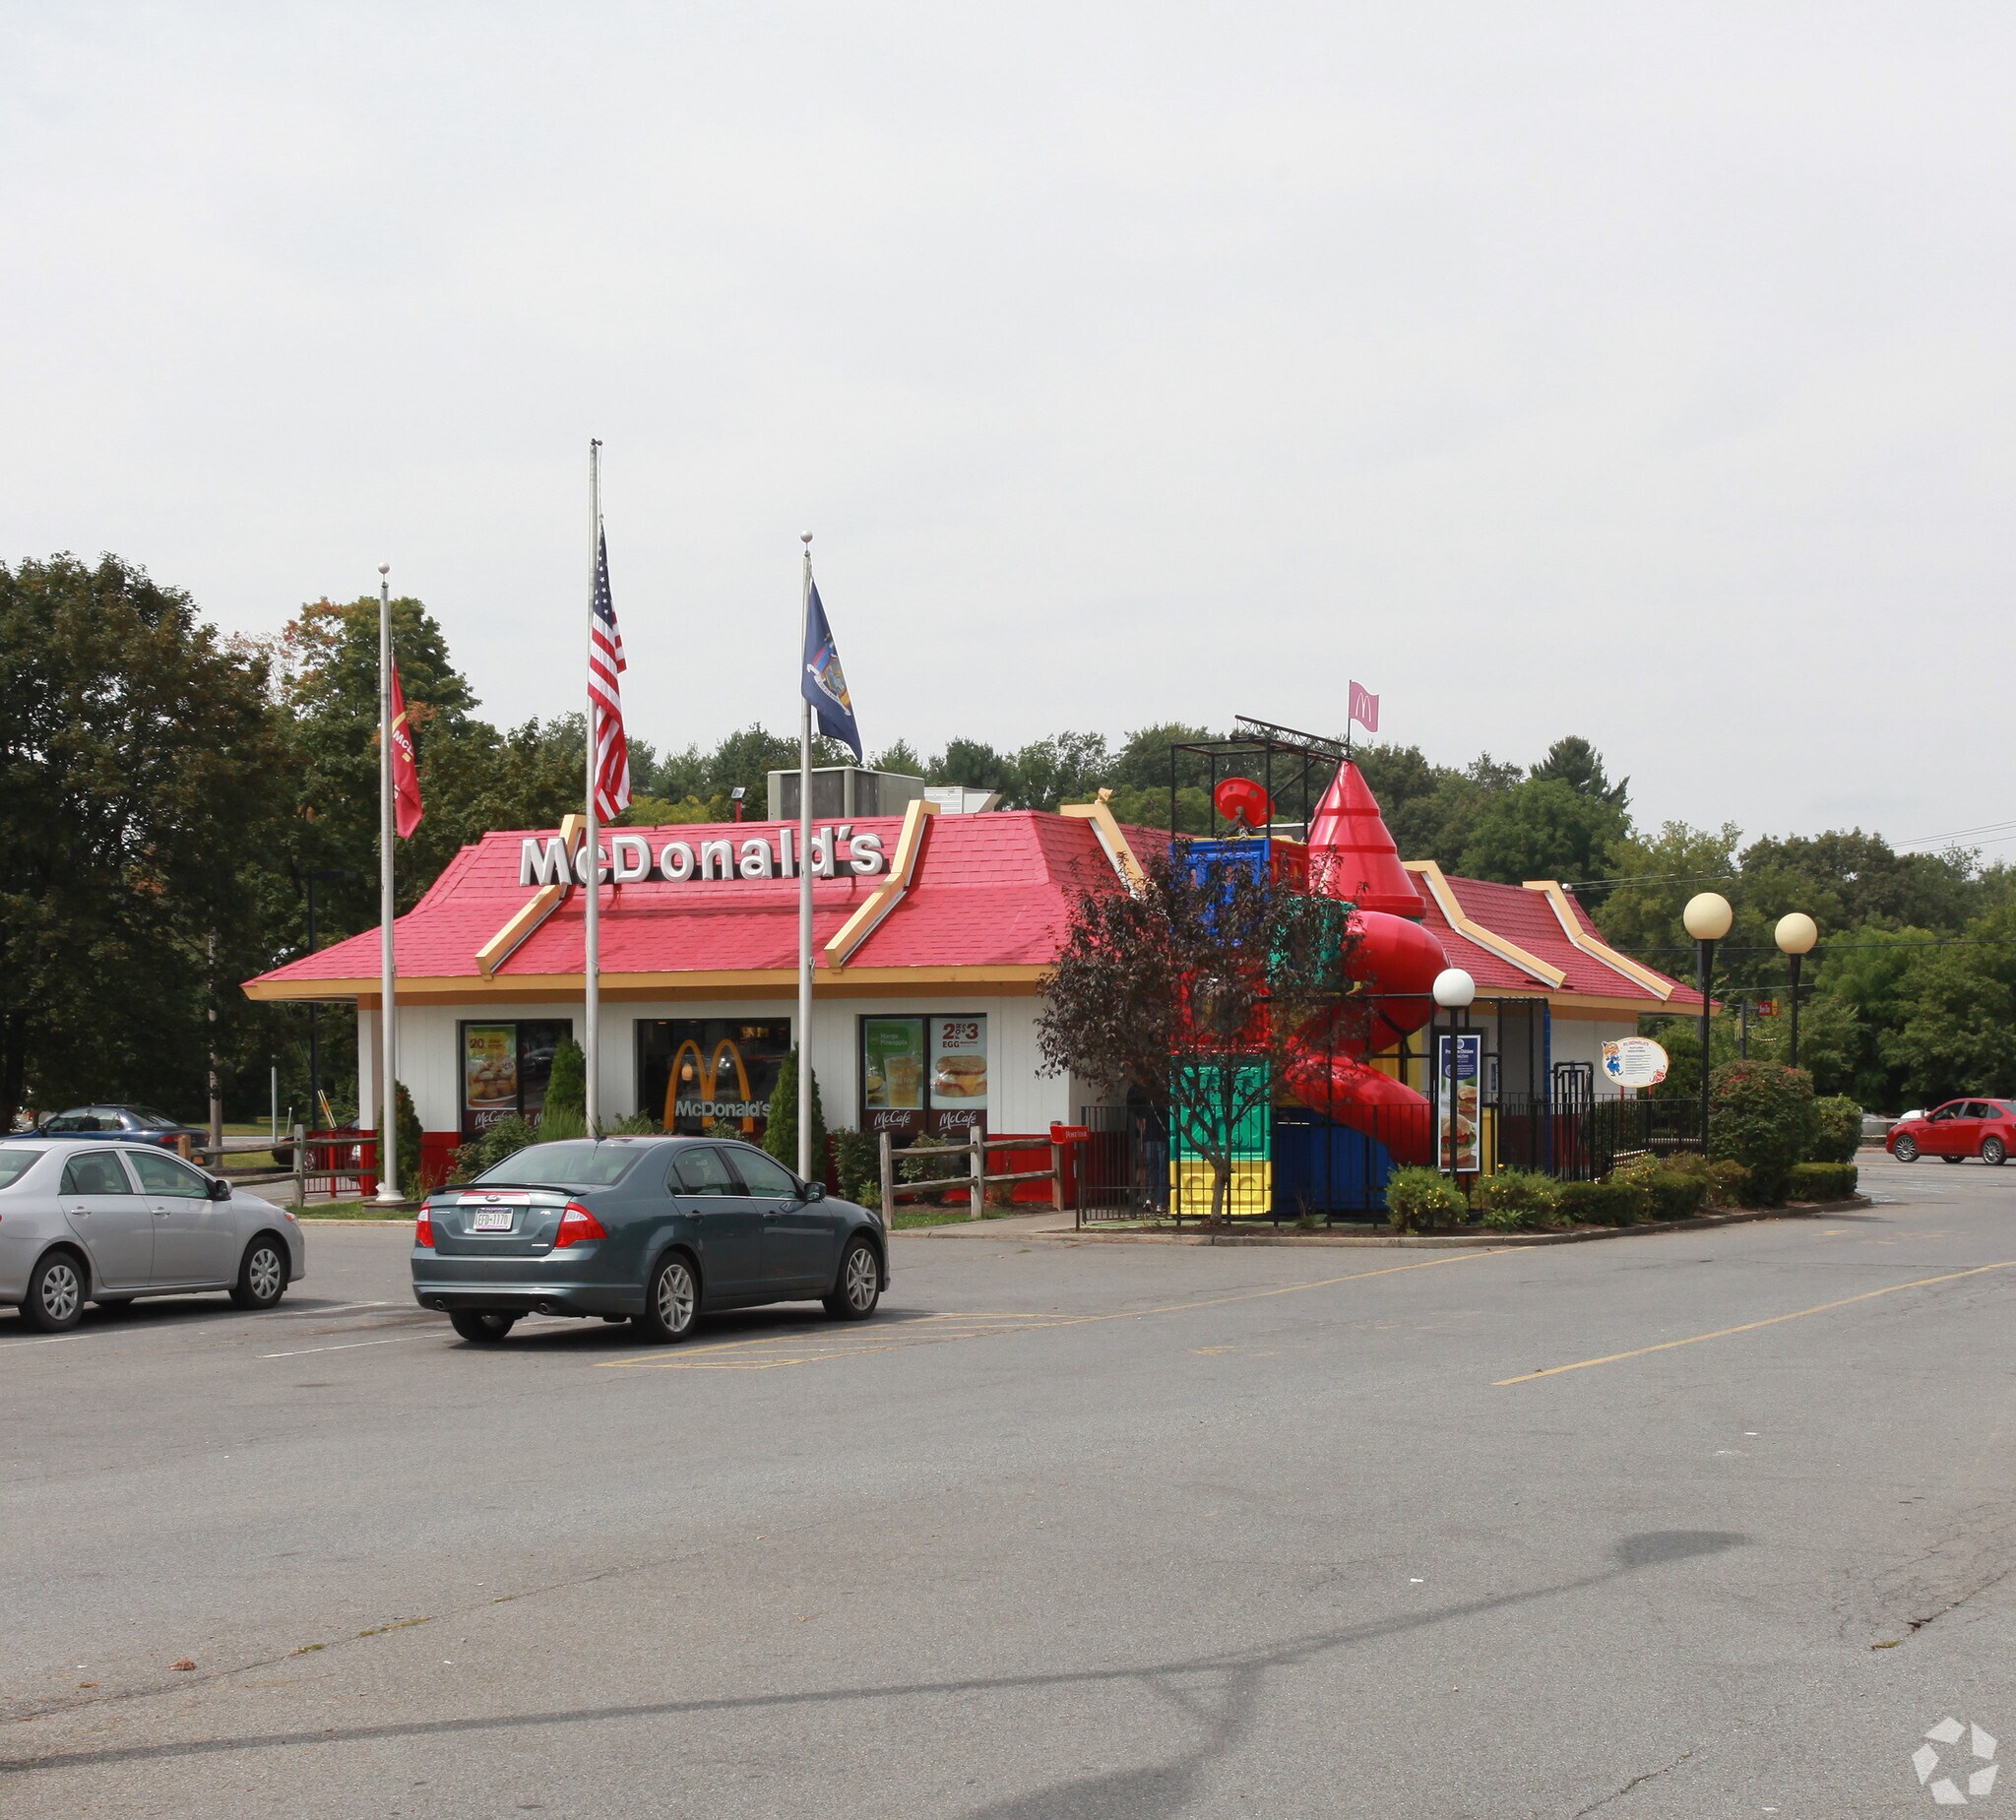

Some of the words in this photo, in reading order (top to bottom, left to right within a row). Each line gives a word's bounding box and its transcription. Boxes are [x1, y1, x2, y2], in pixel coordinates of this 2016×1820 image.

[520, 825, 884, 886] McDonald's
[470, 1038, 485, 1049] 20
[675, 1099, 772, 1117] McDonald's
[874, 1110, 911, 1129] McCafé
[939, 1110, 976, 1130] McCafé
